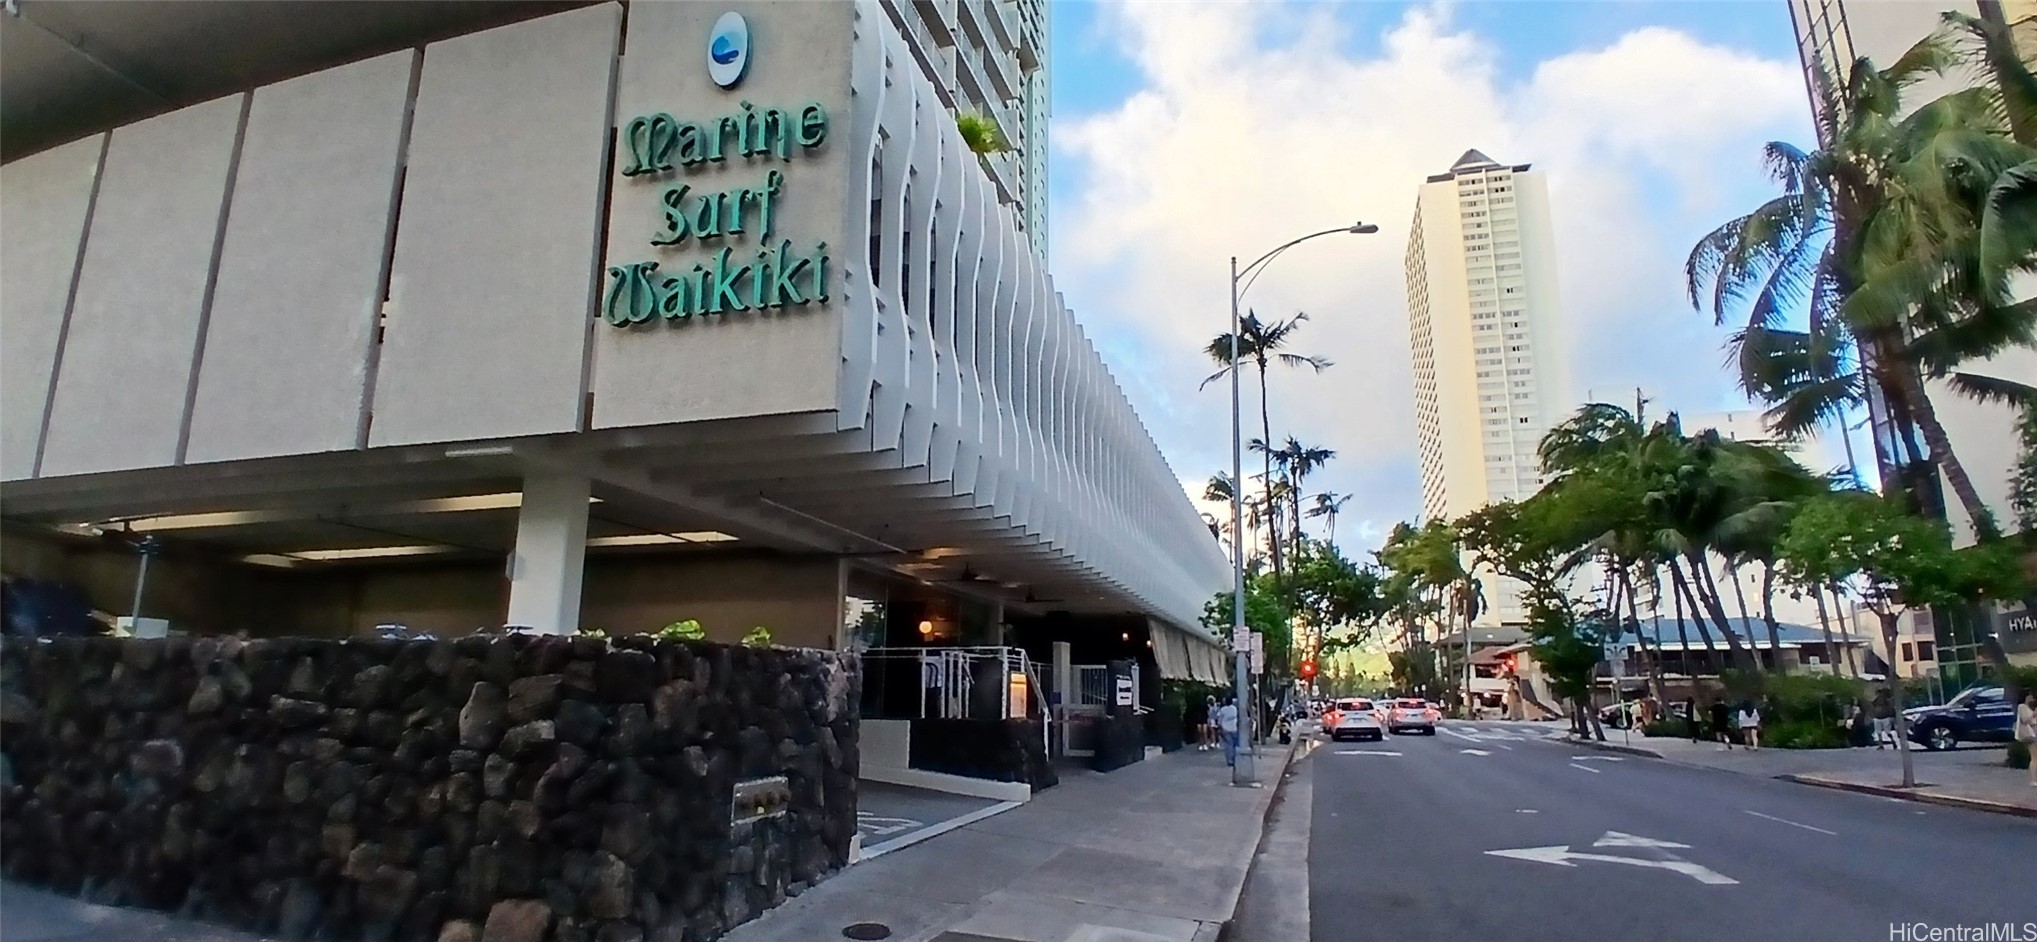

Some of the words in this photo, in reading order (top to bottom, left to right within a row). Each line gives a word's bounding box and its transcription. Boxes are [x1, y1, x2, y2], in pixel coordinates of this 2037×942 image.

[621, 100, 829, 177] Marine
[650, 169, 783, 247] Surf
[602, 239, 830, 328] Waikiki
